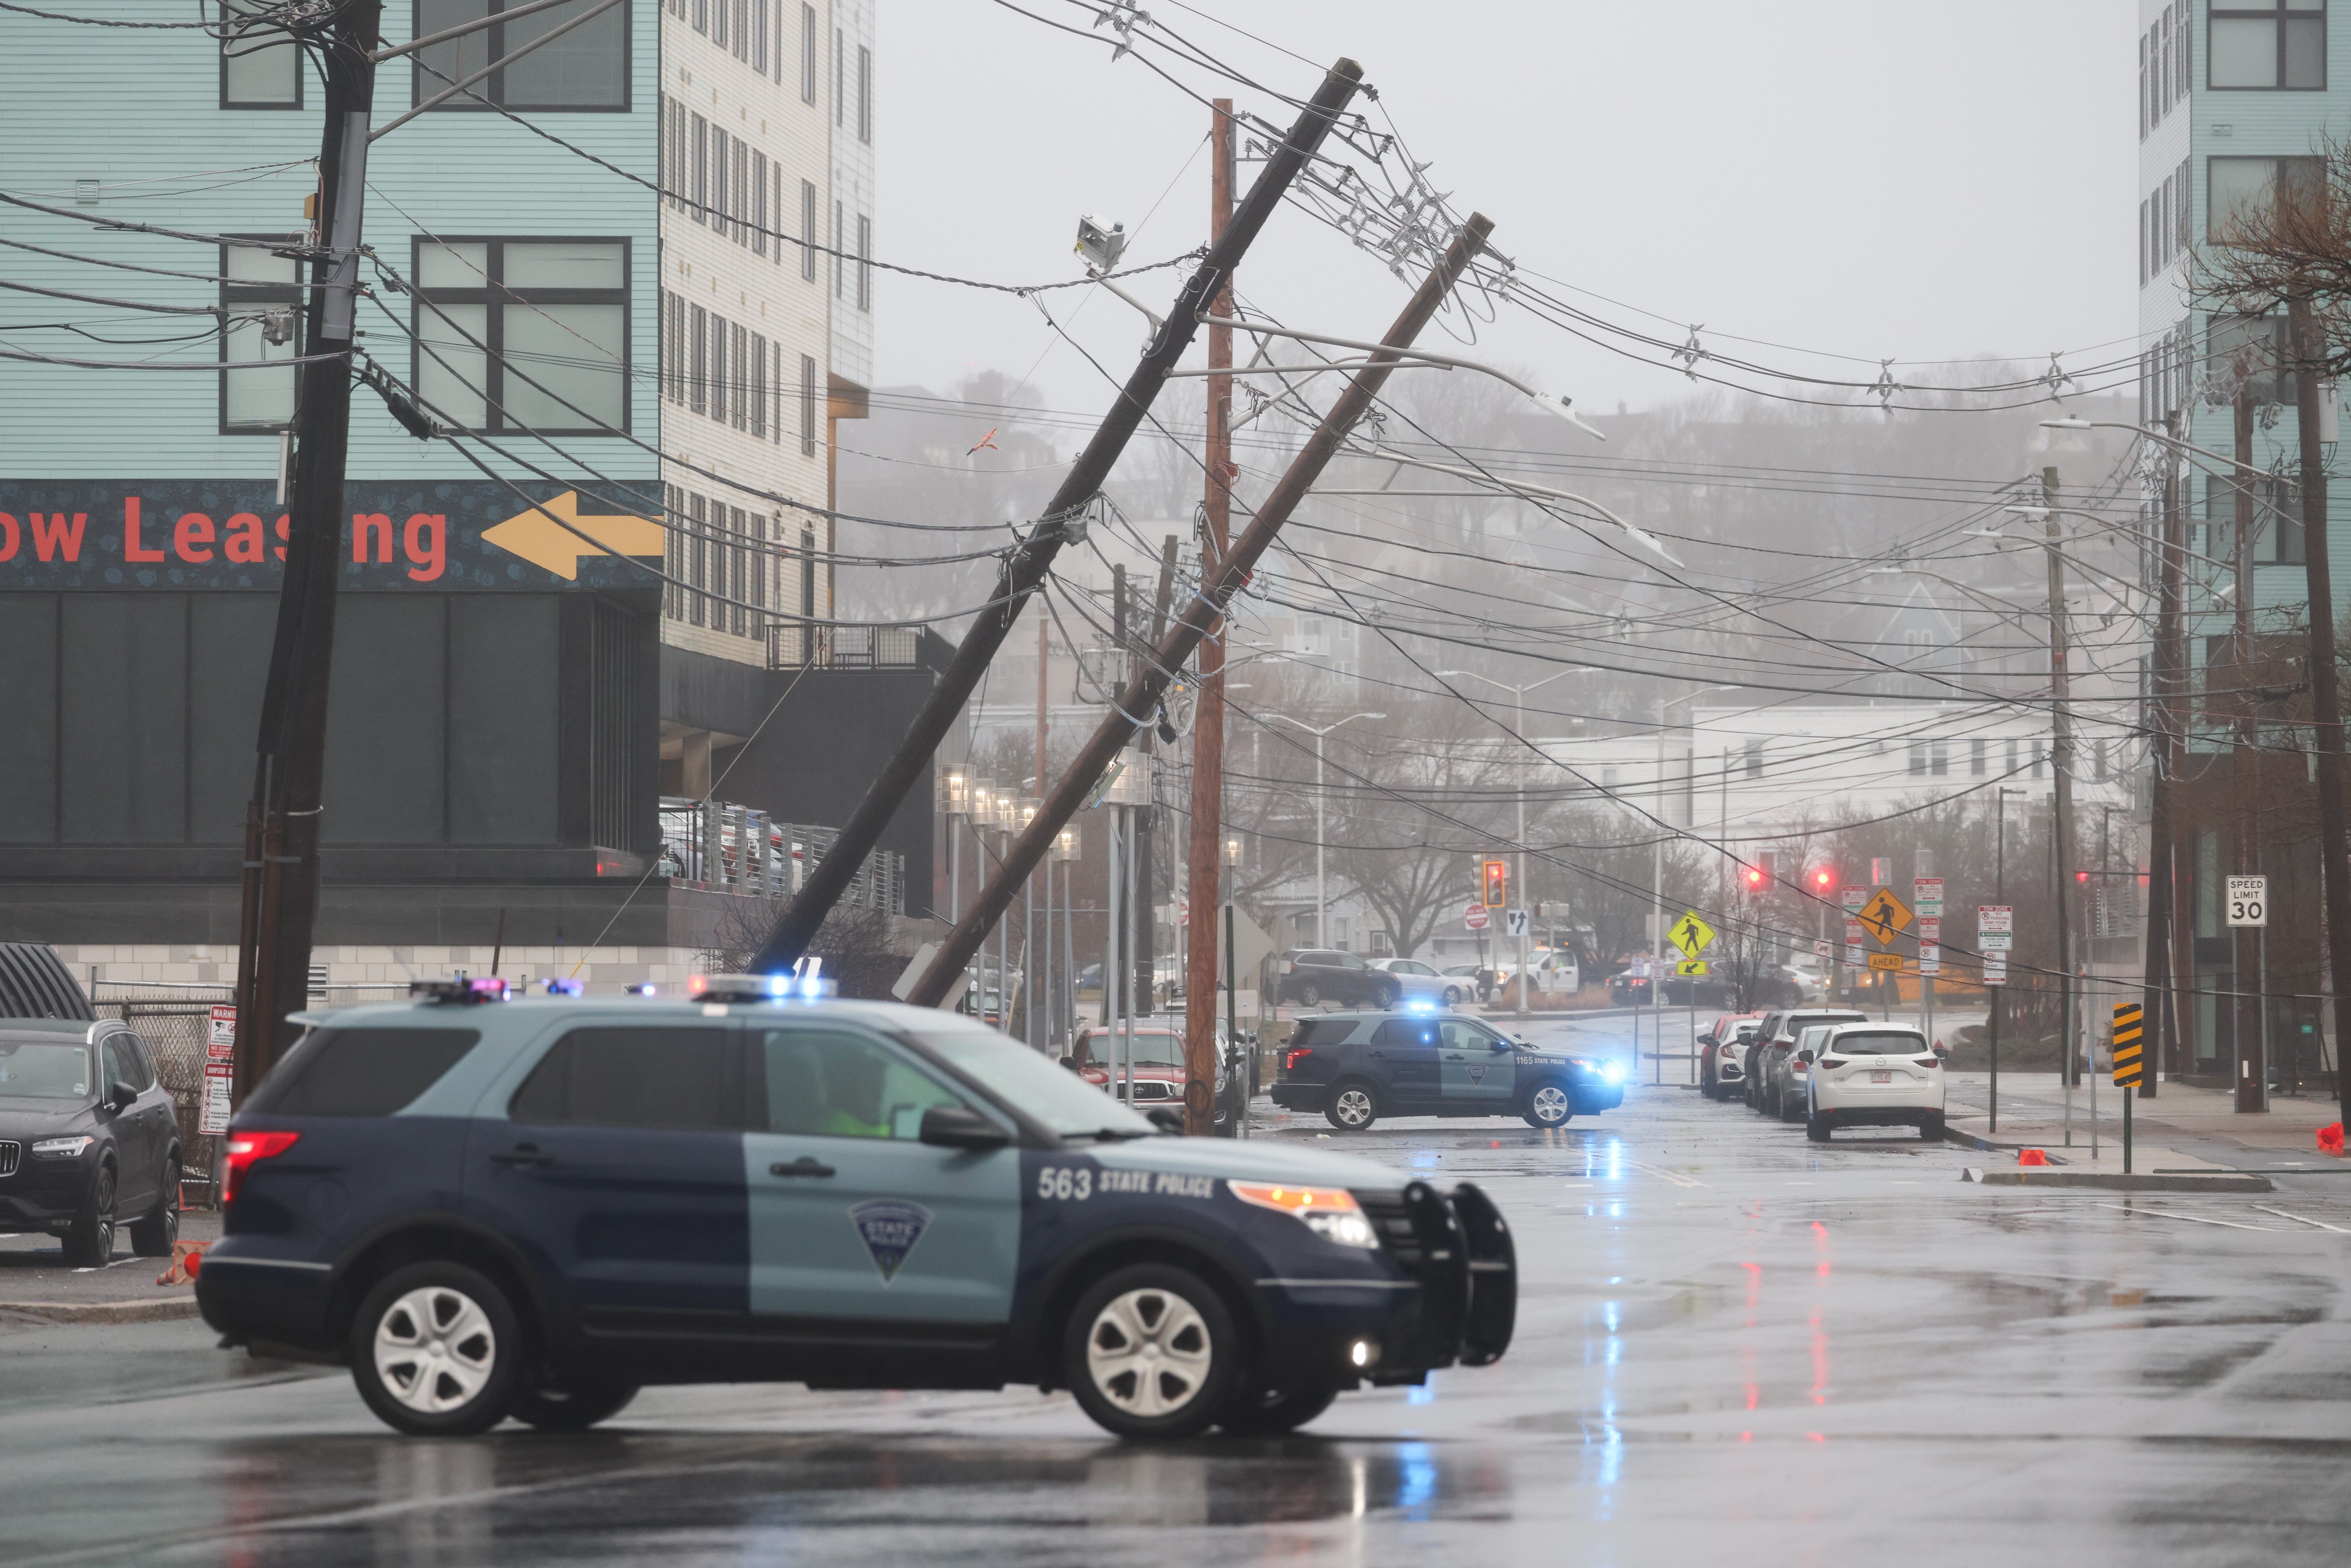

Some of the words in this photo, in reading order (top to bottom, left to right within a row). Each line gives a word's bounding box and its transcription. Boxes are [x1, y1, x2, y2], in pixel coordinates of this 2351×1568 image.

[125, 497, 446, 581] Leang
[2230, 880, 2263, 888] SPEED
[2232, 902, 2262, 919] 30
[1873, 957, 1899, 966] AHEAD
[1516, 1056, 1533, 1065] 1165
[1037, 1166, 1092, 1200] 563
[1099, 1170, 1150, 1192] STATE
[1155, 1173, 1214, 1198] POLICE
[866, 1221, 914, 1235] STATE
